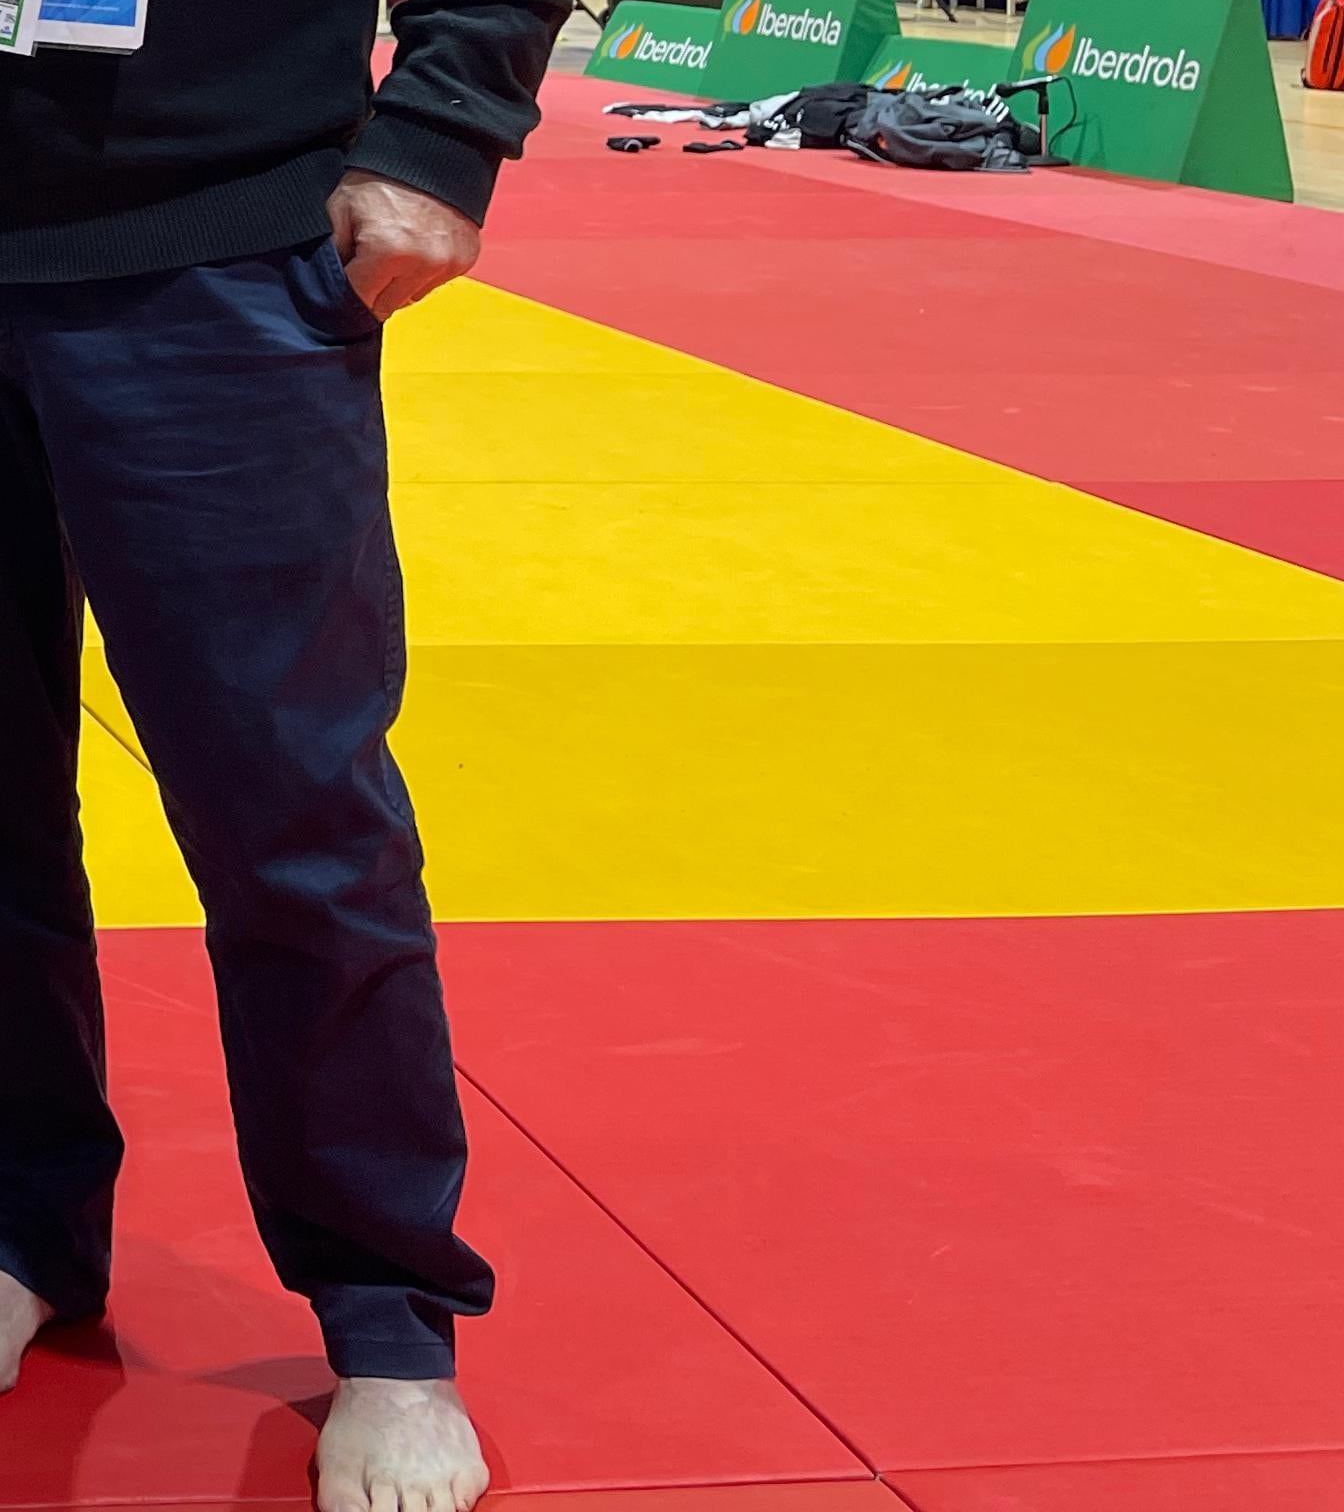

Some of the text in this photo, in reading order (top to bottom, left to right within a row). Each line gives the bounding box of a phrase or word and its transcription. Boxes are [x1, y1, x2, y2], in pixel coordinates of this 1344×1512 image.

[756, 3, 842, 46] Iberdrola
[634, 31, 714, 69] Iberdrol
[1071, 37, 1201, 92] Iberdrola
